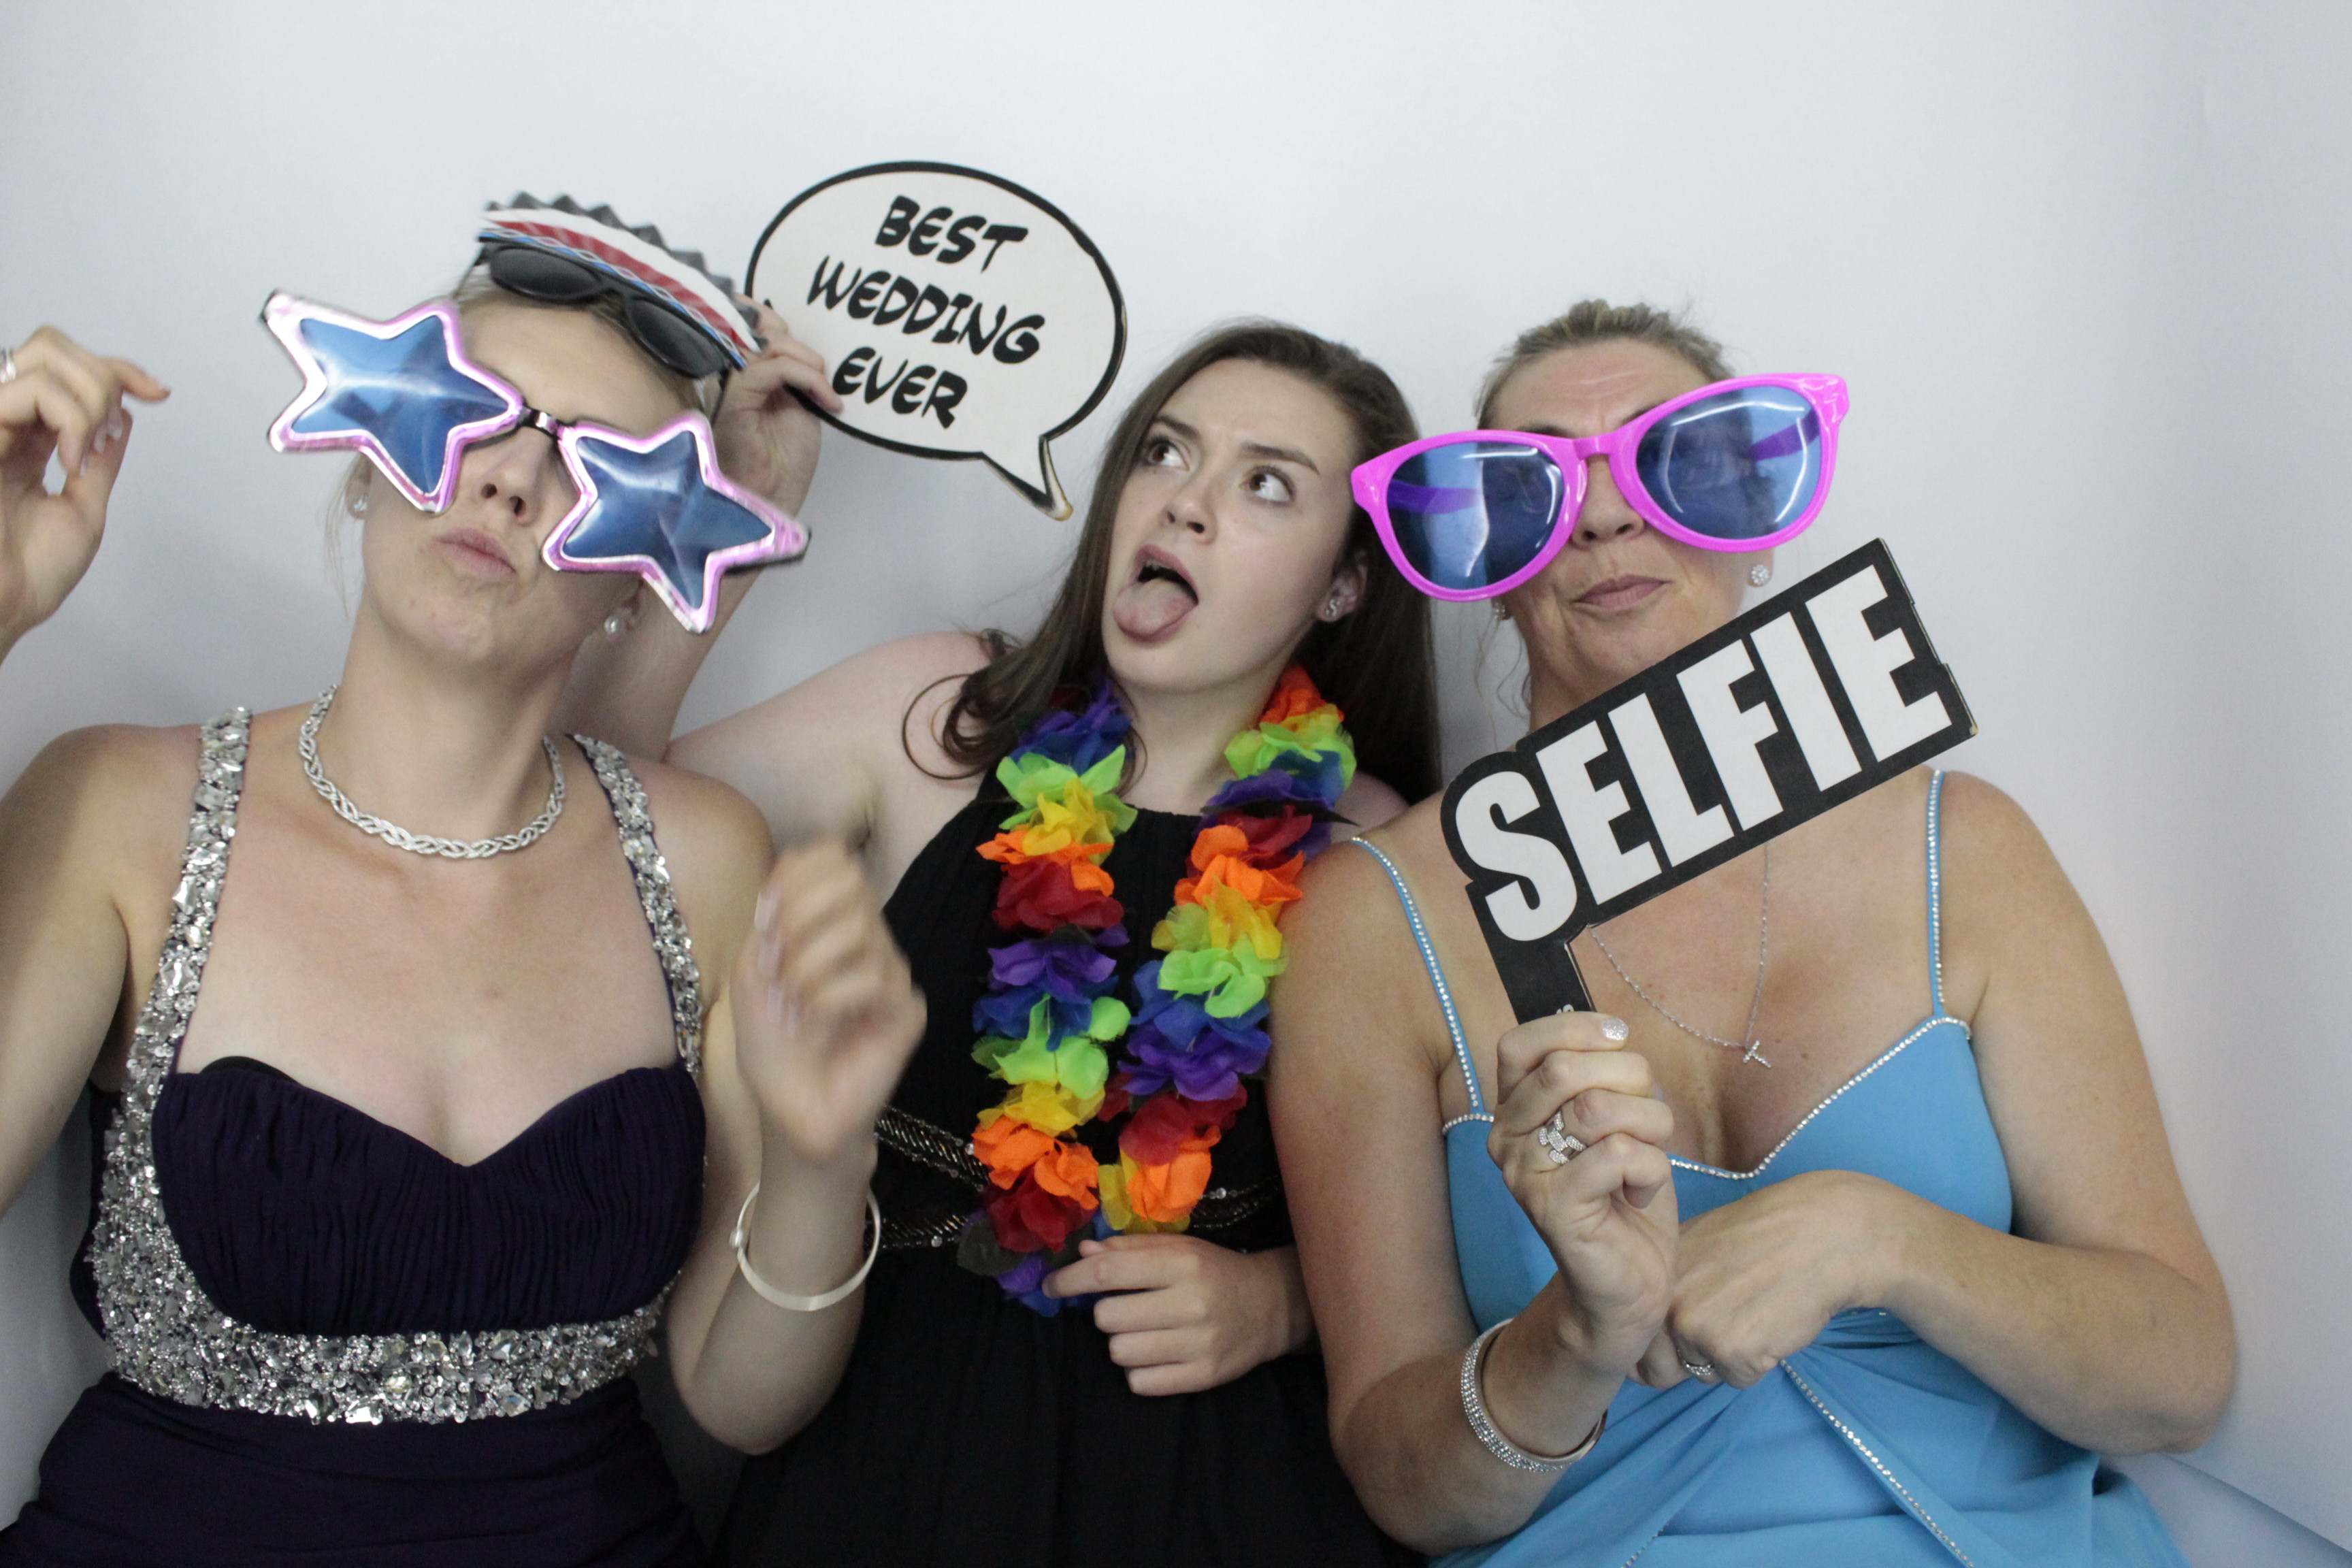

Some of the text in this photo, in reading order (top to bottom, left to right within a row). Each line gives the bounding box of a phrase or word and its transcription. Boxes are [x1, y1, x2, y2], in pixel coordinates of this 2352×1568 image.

[875, 195, 1028, 272] BEST
[807, 256, 1045, 365] WEDDING
[832, 347, 968, 429] EVER
[1455, 564, 1953, 942] SELFIE
